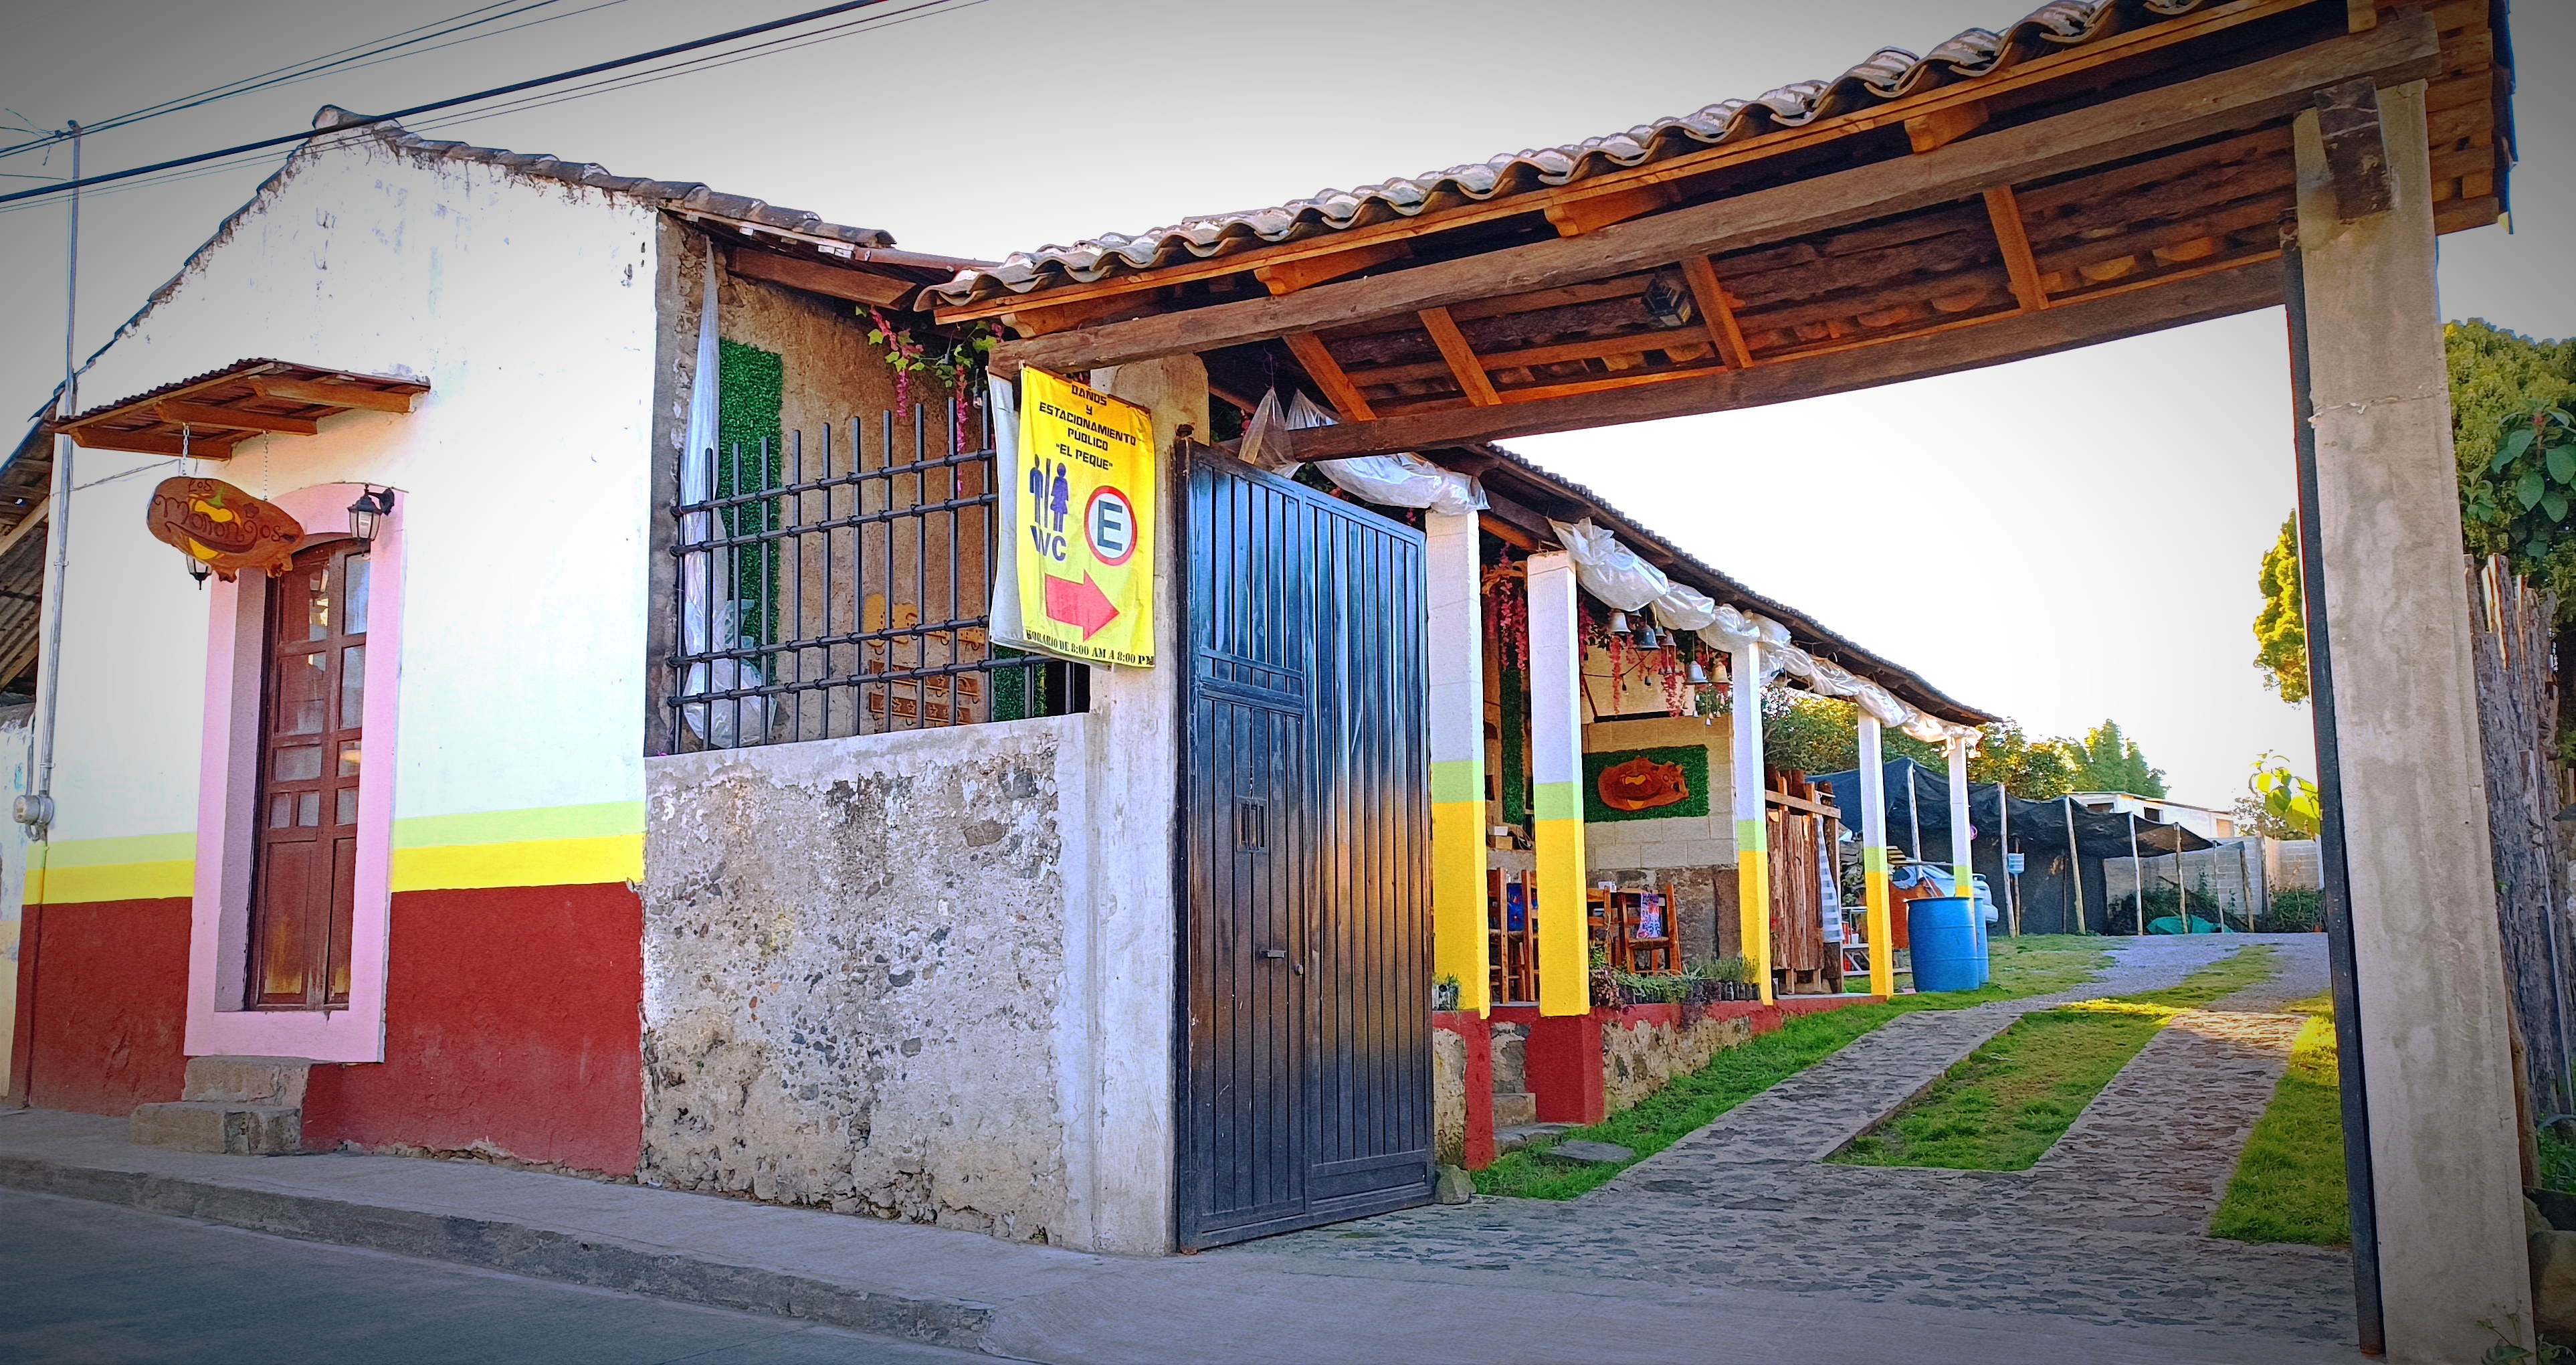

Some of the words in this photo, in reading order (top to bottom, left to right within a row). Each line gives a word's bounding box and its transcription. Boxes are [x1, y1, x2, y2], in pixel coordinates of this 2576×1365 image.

[1039, 401, 1136, 446] ESTACIONAMIENTO
[1068, 428, 1108, 452] PÚBLICO
[1029, 525, 1067, 561] WC
[1025, 629, 1058, 648] HORARIO
[1059, 640, 1070, 652] DE
[1071, 643, 1089, 656] 8:00
[1092, 647, 1106, 658] AM
[1108, 650, 1115, 660] A
[1117, 652, 1136, 664] 8:00
